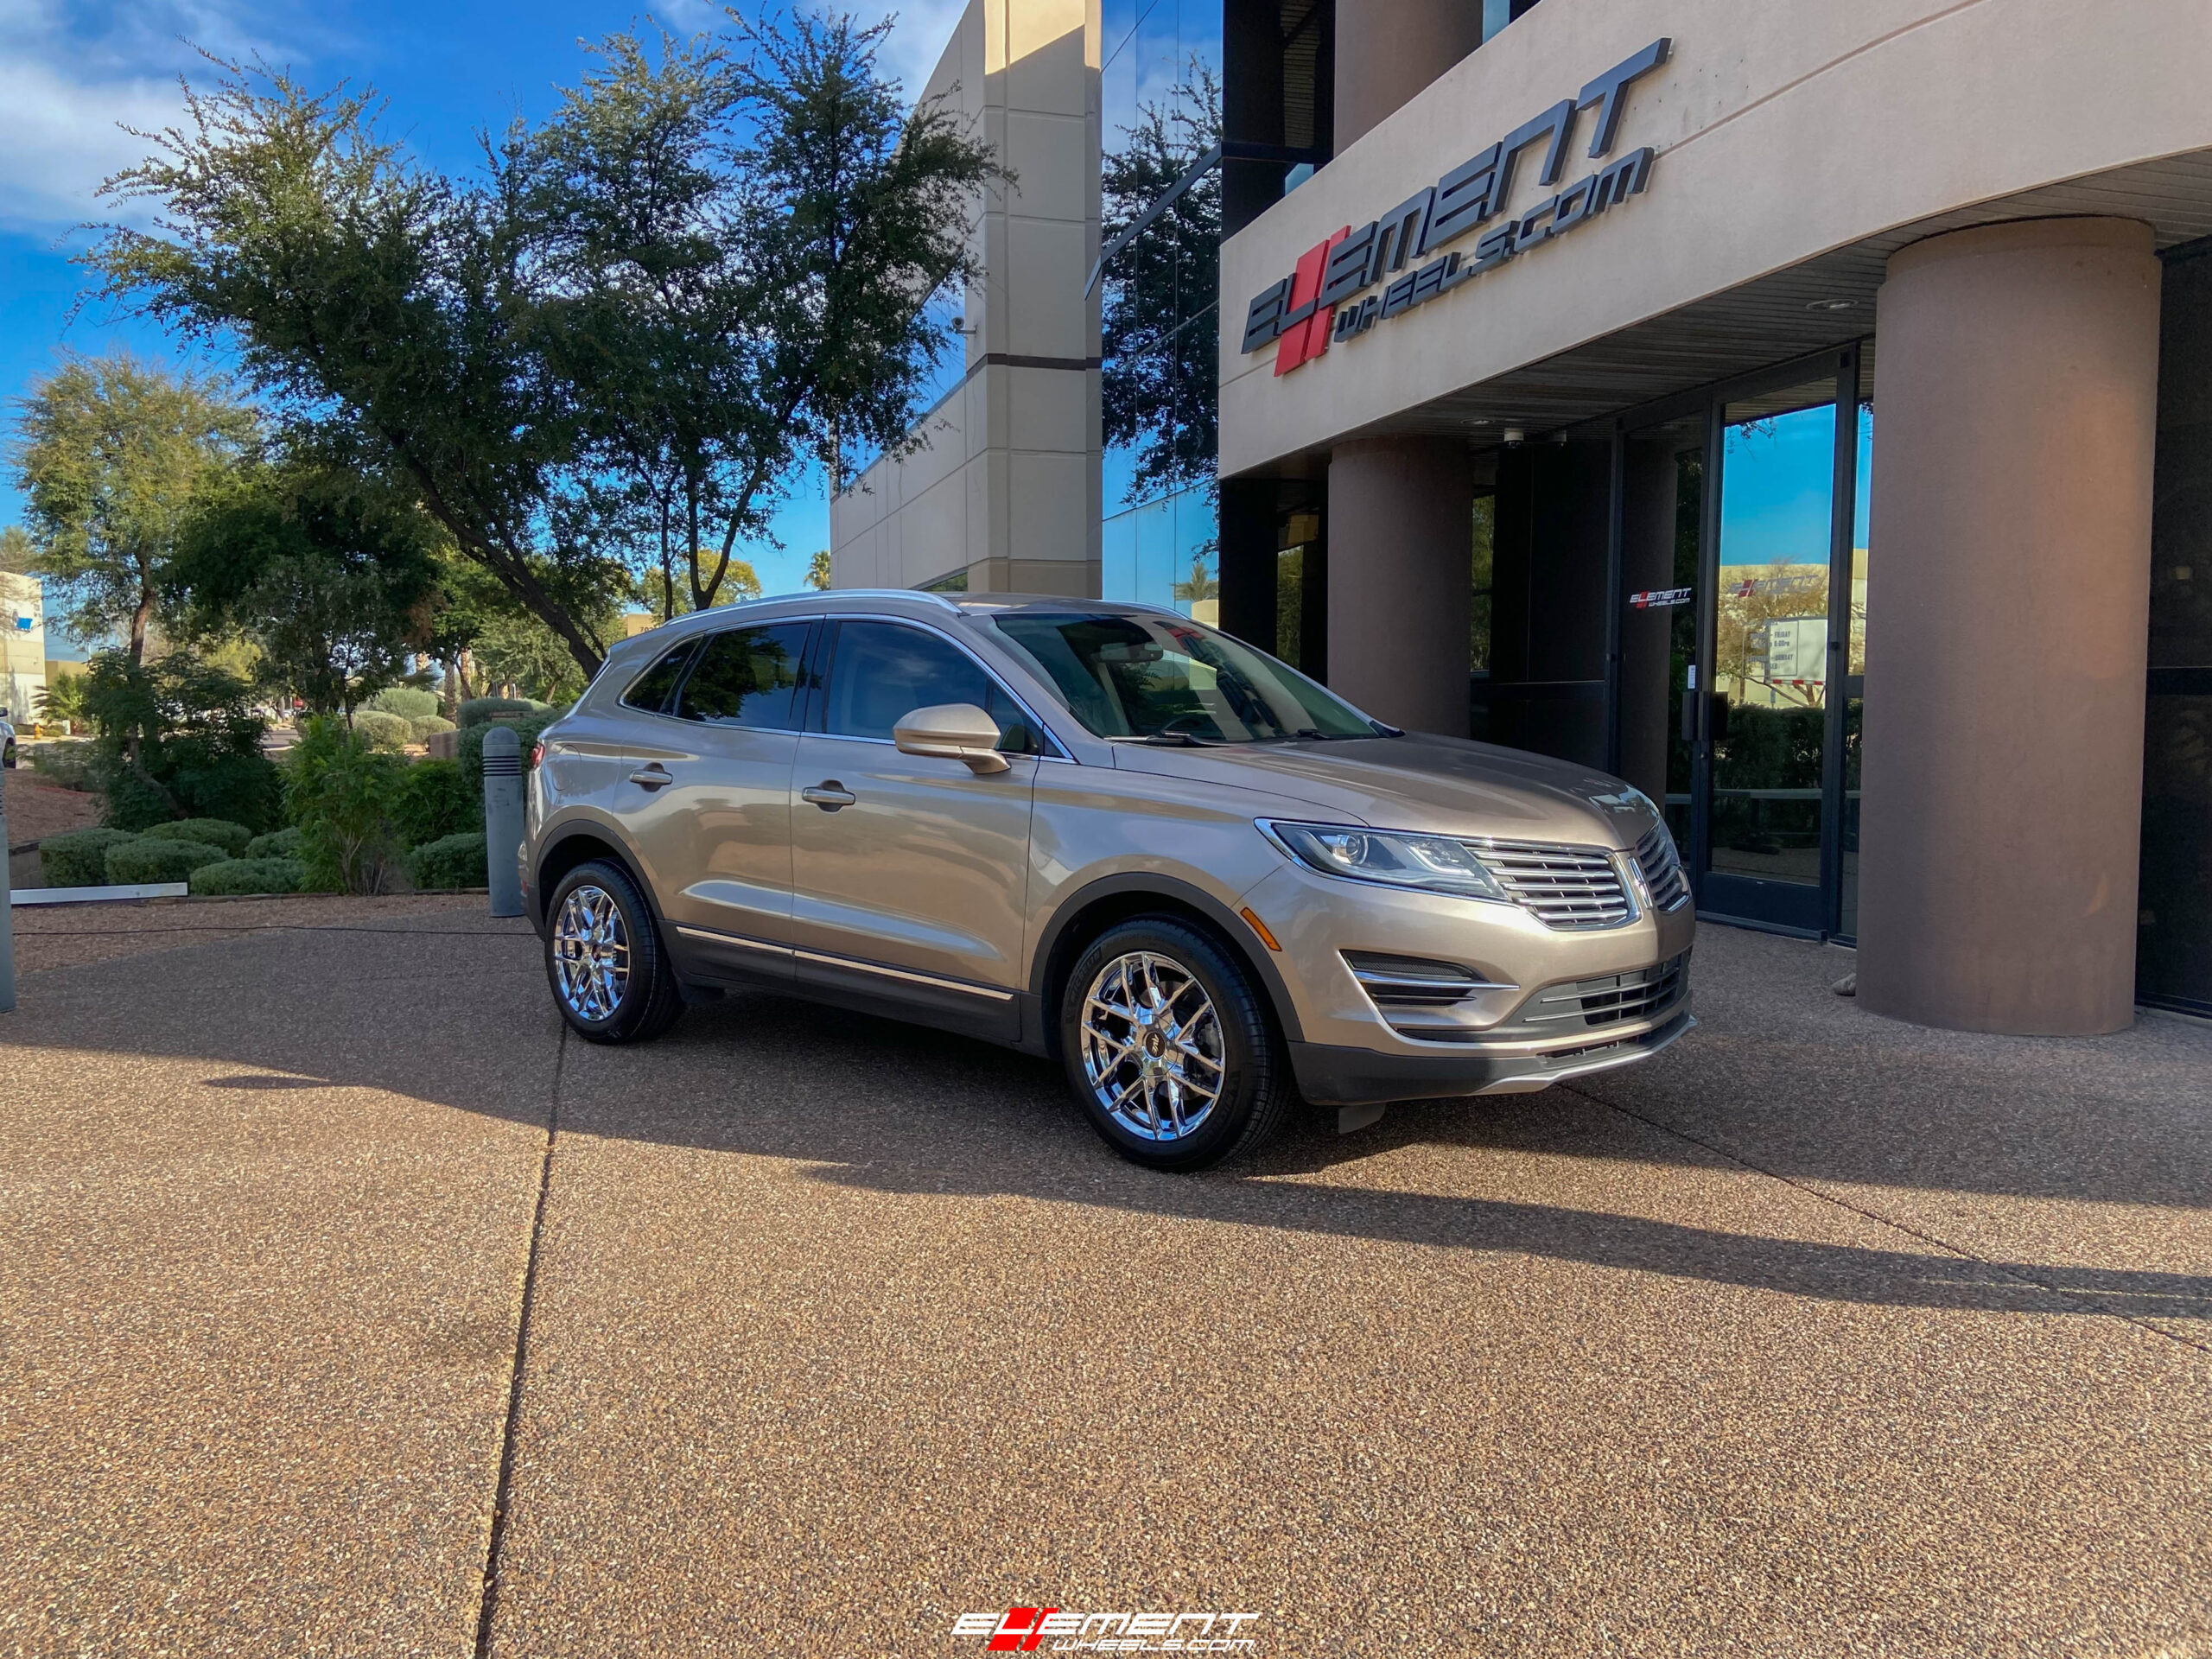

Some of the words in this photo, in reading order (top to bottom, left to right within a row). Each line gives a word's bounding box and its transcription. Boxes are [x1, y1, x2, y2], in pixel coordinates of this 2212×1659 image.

[1242, 37, 1672, 354] ELEMENT
[1334, 147, 1655, 343] WHEELS.COM
[1630, 588, 1692, 603] ELEMENT
